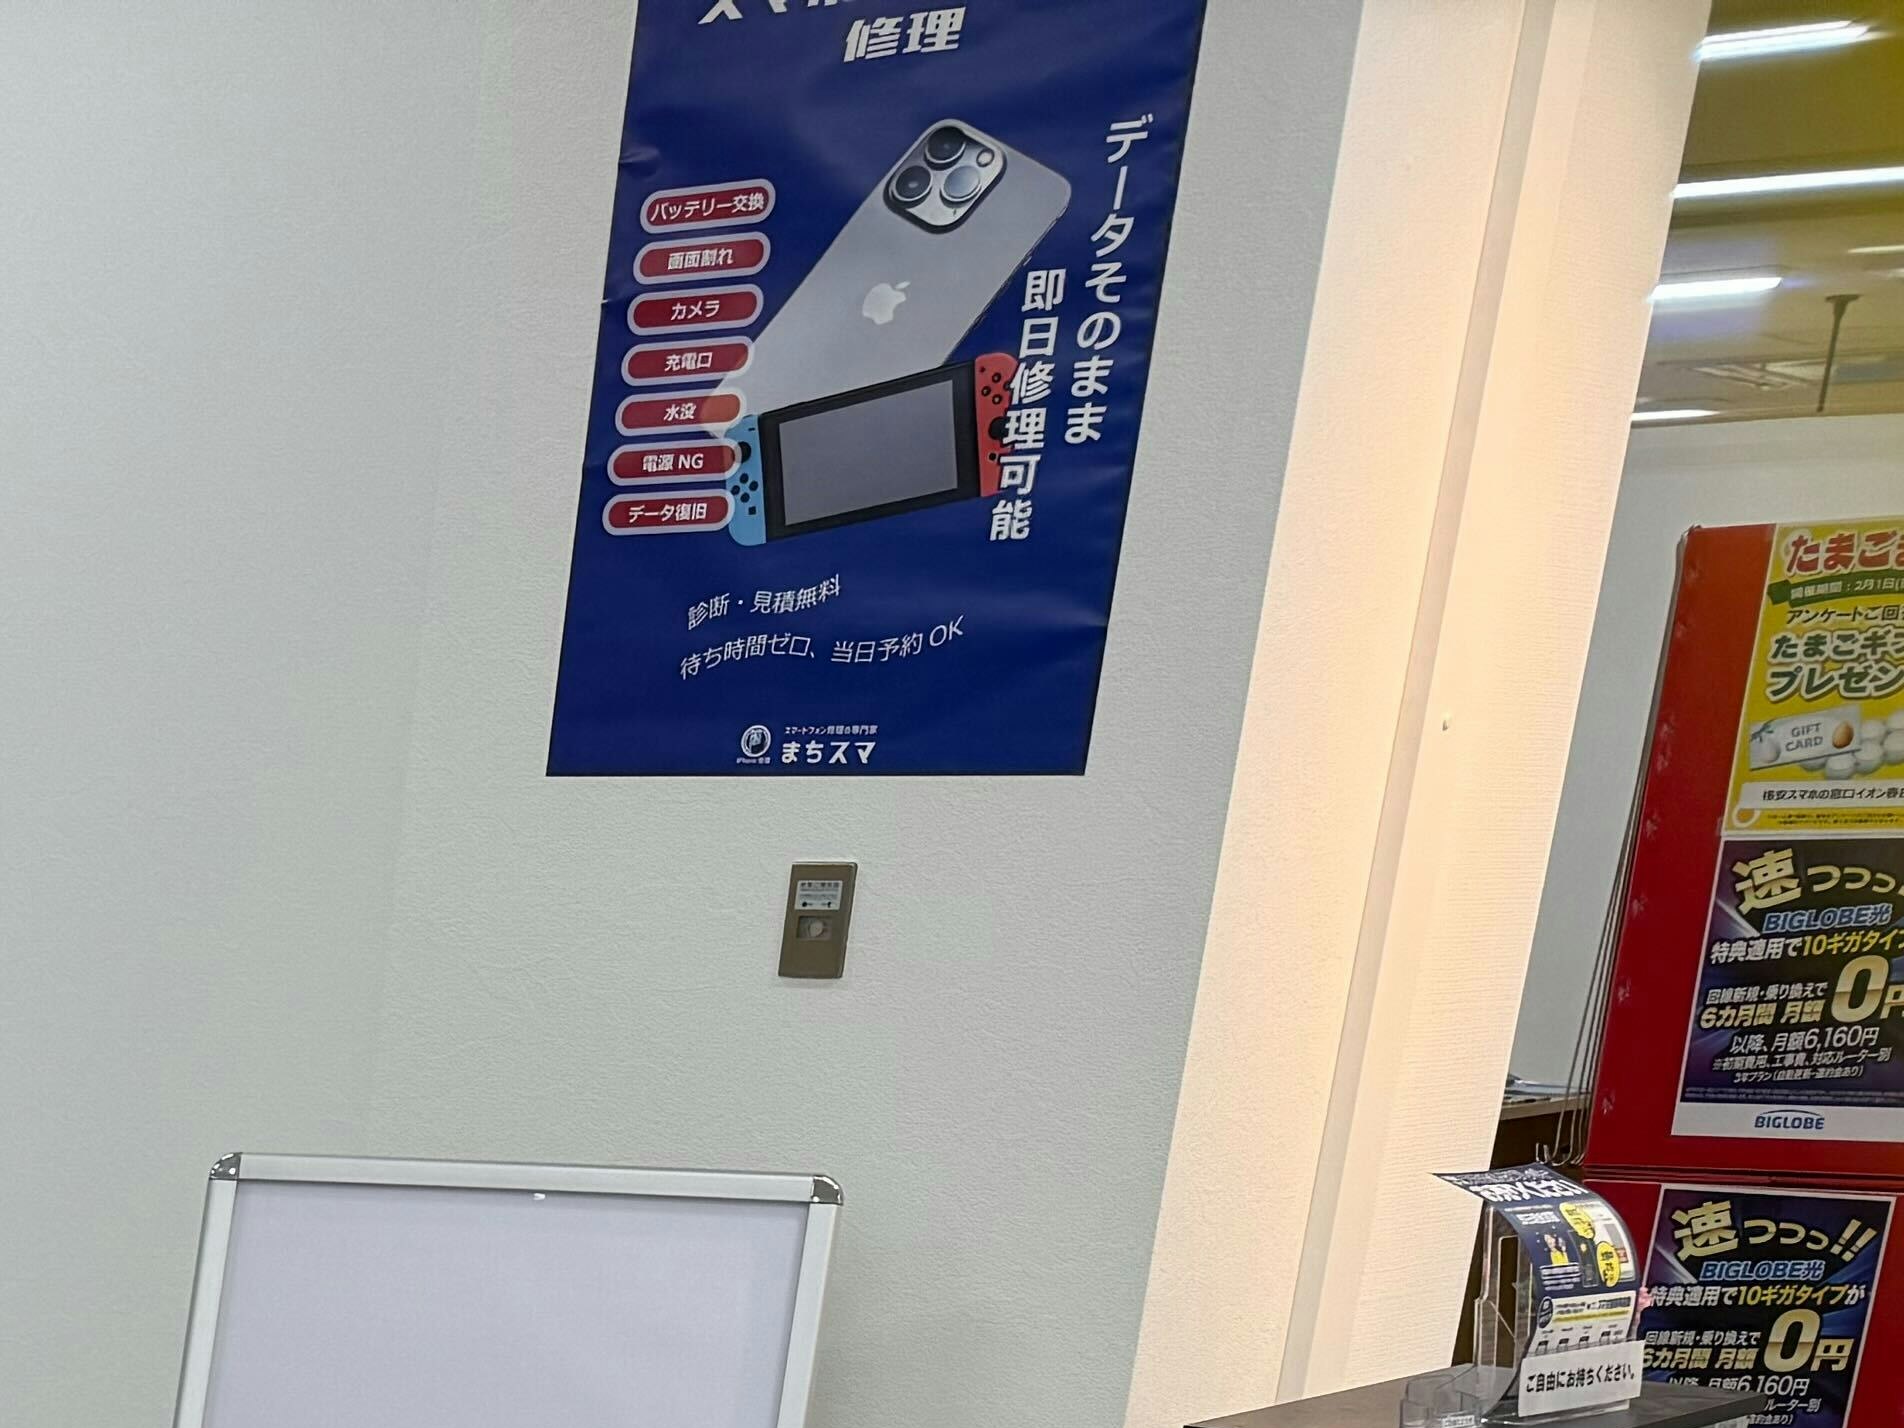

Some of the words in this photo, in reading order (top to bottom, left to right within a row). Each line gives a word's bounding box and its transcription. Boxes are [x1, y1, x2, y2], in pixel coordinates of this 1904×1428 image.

[844, 7, 966, 63] 修理
[650, 192, 765, 222] バッテリー交換
[668, 249, 734, 270] 画面割れ
[1064, 113, 1153, 445] データそのまま
[670, 300, 720, 320] カメラ
[664, 352, 713, 371] 充電口
[663, 403, 696, 421] 水没
[990, 268, 1067, 541] 即日修理可能
[643, 454, 673, 472] 電源
[678, 454, 704, 469] NG
[629, 503, 707, 523] データ復旧
[1786, 529, 1904, 575] たまご
[687, 574, 841, 630] 診断・見積無料
[1786, 604, 1904, 625] アンケートご回
[929, 614, 964, 648] OK
[1791, 722, 1822, 739] GIFT
[781, 740, 876, 764] まちスマ
[1785, 735, 1823, 752] CARD
[1763, 904, 1892, 933] BIGLOBE光
[1754, 1114, 1825, 1130] BIGLOBE
[1700, 1260, 1825, 1281] BIGLOBE光
[1764, 1308, 1854, 1372] 0円
[1526, 1364, 1635, 1392] ご自由にお持ちください。
